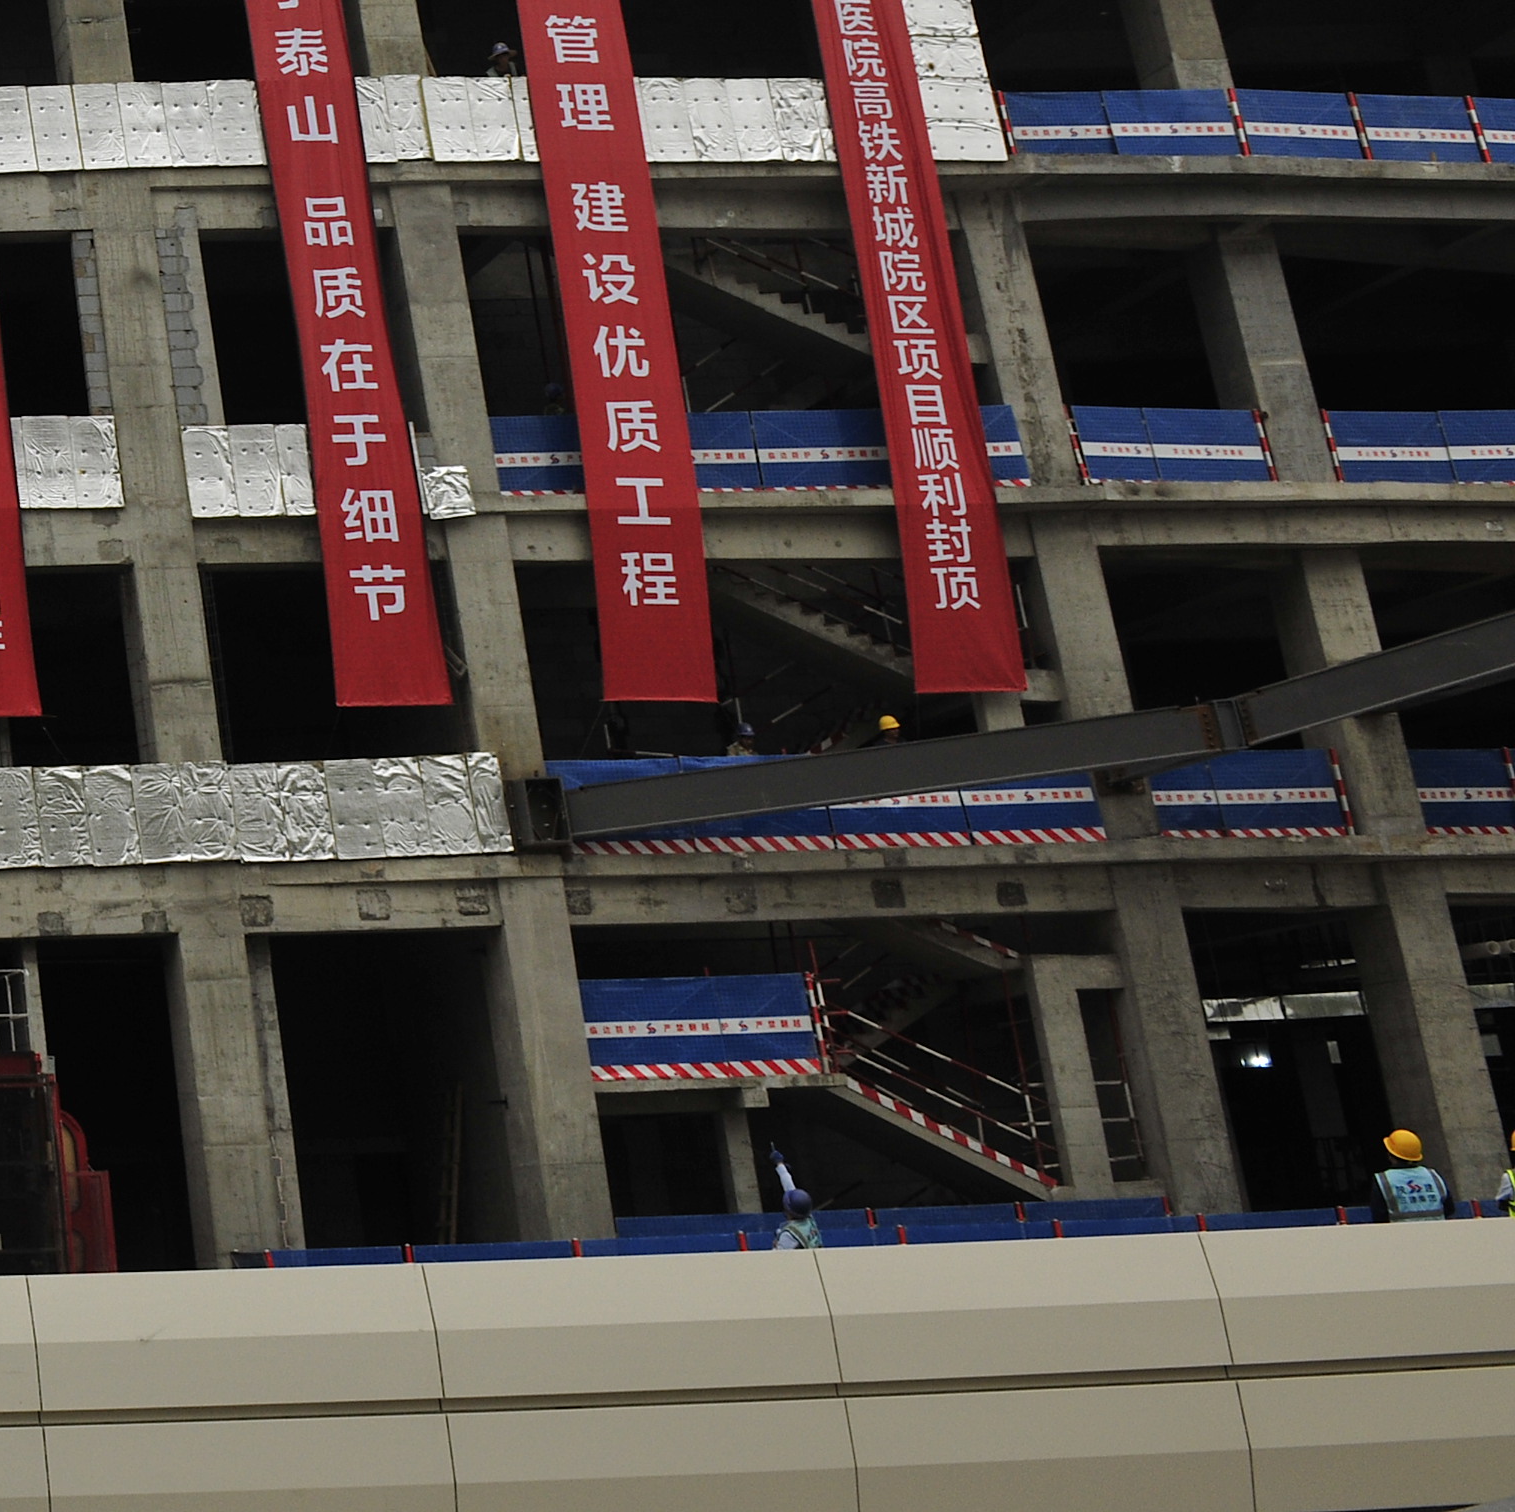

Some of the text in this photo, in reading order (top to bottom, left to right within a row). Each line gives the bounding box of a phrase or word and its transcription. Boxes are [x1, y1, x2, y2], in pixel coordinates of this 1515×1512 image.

[303, 196, 406, 621] 品质在于细节
[571, 181, 680, 606] 建设优质工程
